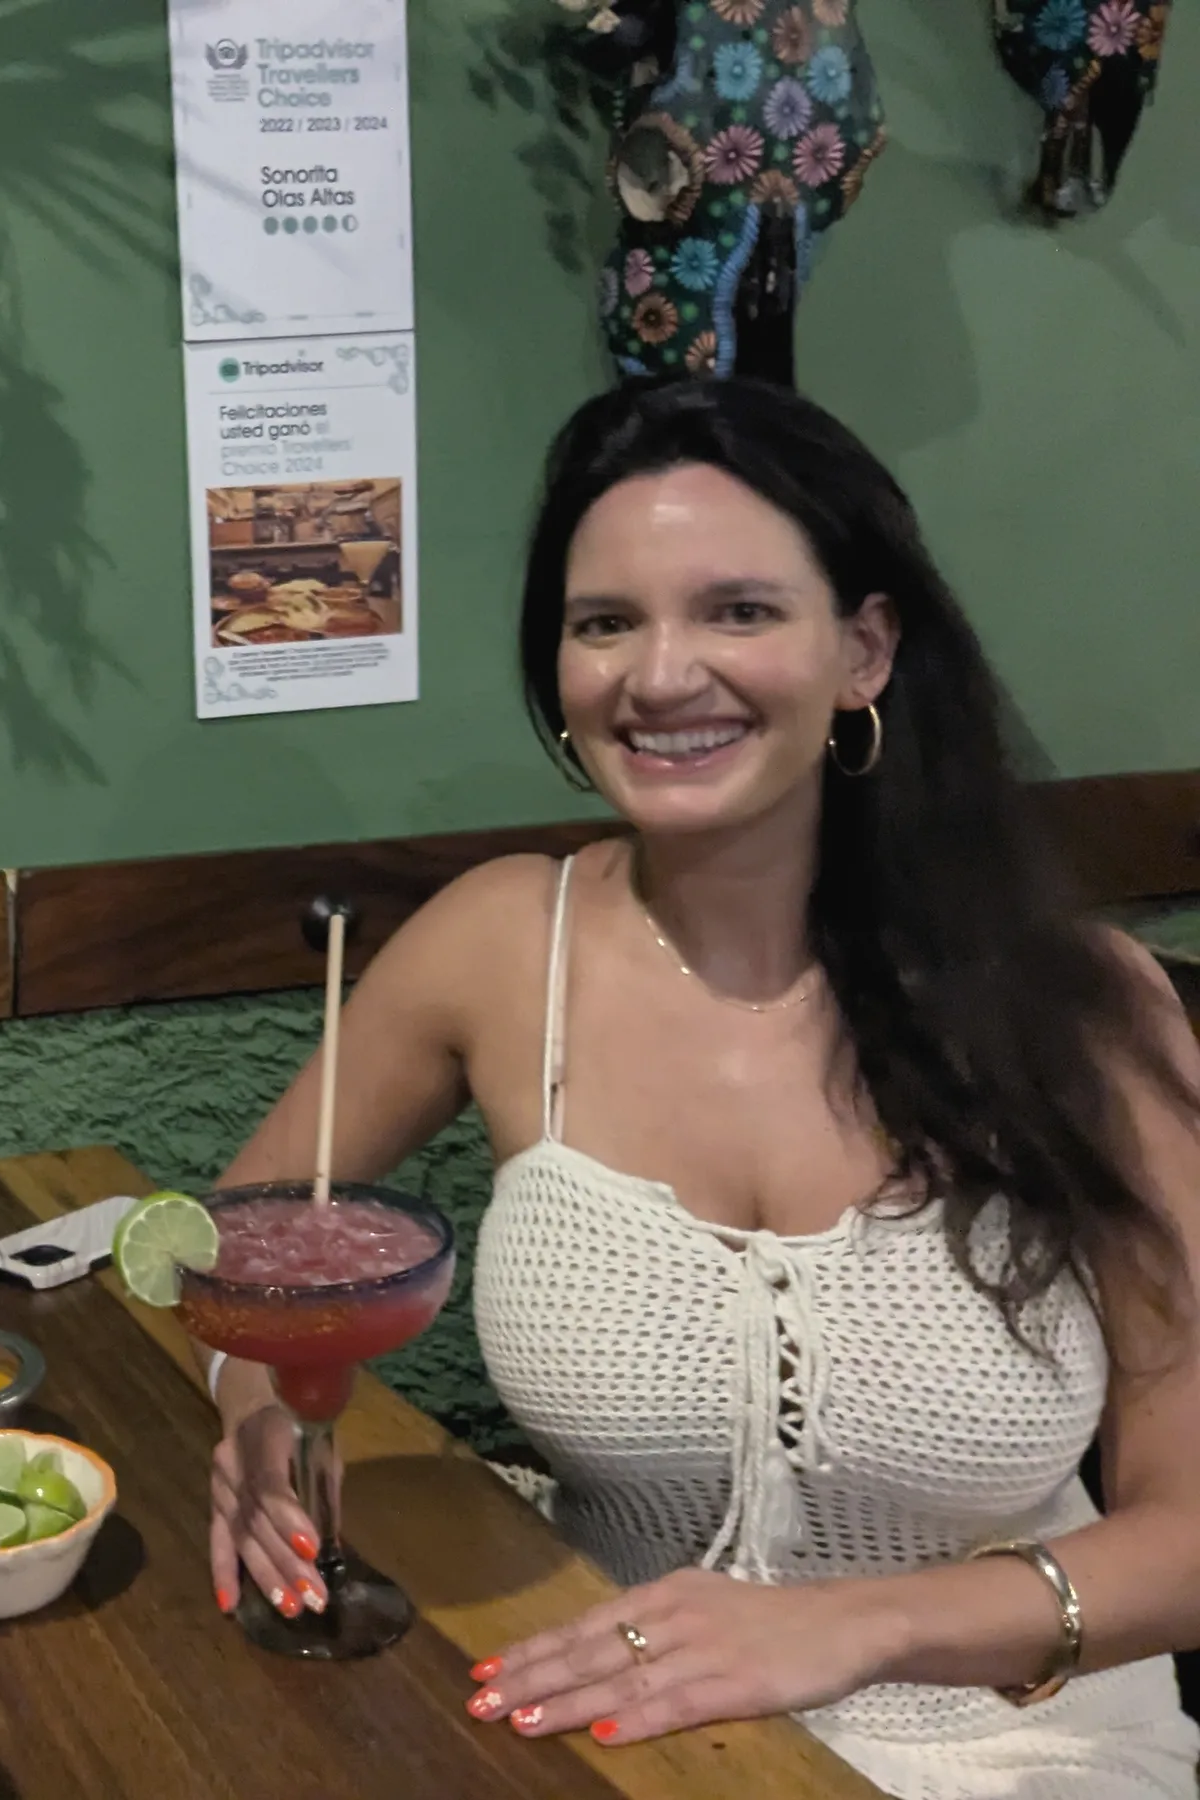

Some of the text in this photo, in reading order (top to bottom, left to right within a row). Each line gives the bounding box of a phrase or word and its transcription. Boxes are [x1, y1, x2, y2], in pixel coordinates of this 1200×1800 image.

[255, 38, 375, 62] Tripadvisor
[257, 63, 360, 85] Travellers
[258, 87, 332, 108] Choice
[260, 118, 294, 133] 2022
[307, 117, 341, 132] 2023
[354, 116, 387, 131] 2024
[261, 165, 338, 185] Sonorita
[262, 188, 355, 208] Olas Altas
[242, 359, 324, 377] Tripadvisor
[219, 402, 328, 421] Felicitaciones
[220, 422, 264, 440] usted
[268, 420, 311, 441] ganó
[222, 456, 323, 477] Choice 2024
